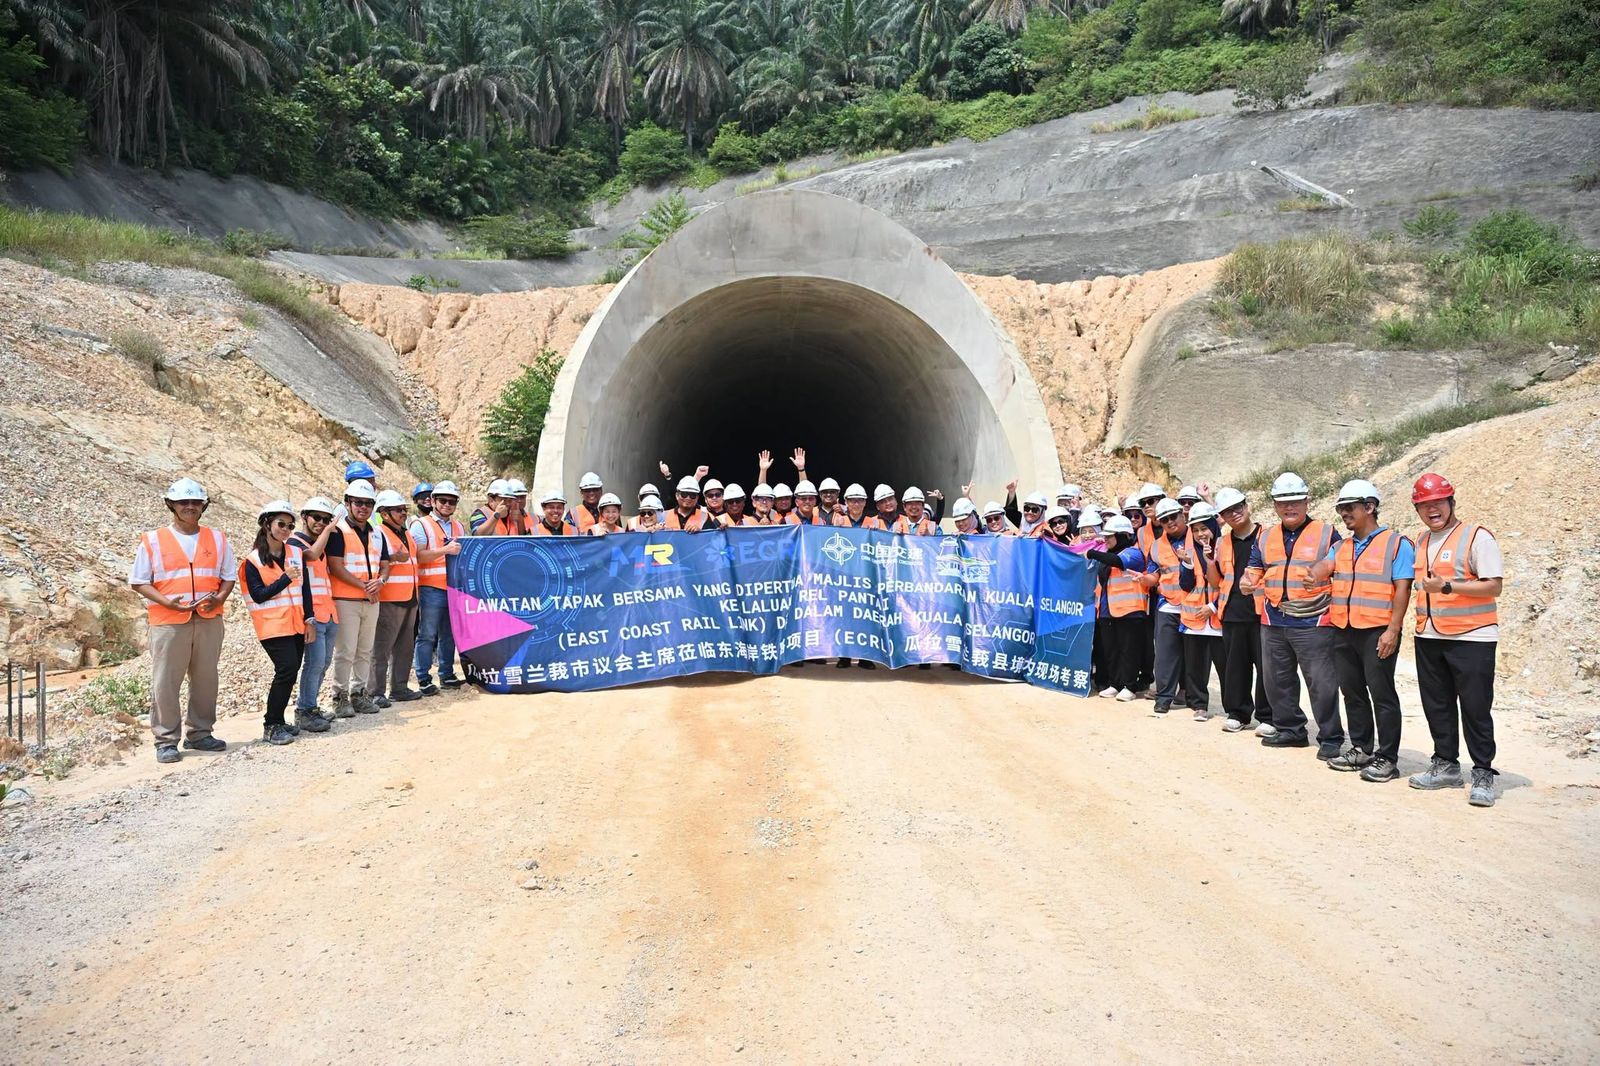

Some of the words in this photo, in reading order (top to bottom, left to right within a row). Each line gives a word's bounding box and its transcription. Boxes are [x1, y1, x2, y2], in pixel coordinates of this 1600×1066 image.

[738, 538, 796, 564] ECR
[465, 597, 541, 614] LAWATAN
[553, 594, 604, 610] TAPAK
[613, 585, 686, 606] BERSAMA
[693, 582, 731, 597] YANG
[813, 574, 872, 589] MAJLIS
[878, 580, 976, 603] PERBANDARAN
[985, 590, 1034, 608] KUALA
[1040, 597, 1083, 616] SELANGOR
[799, 589, 827, 602] REL
[839, 590, 889, 611] PANTAI
[558, 630, 609, 650] (EAST
[619, 621, 671, 640] COAST
[682, 617, 720, 631] RAIL
[728, 616, 766, 633] LINK)
[777, 613, 788, 630] D
[795, 605, 843, 620] DALAM
[853, 607, 902, 627] DAERAH
[914, 611, 962, 626] KUALA
[965, 622, 1036, 646] SELANGOR
